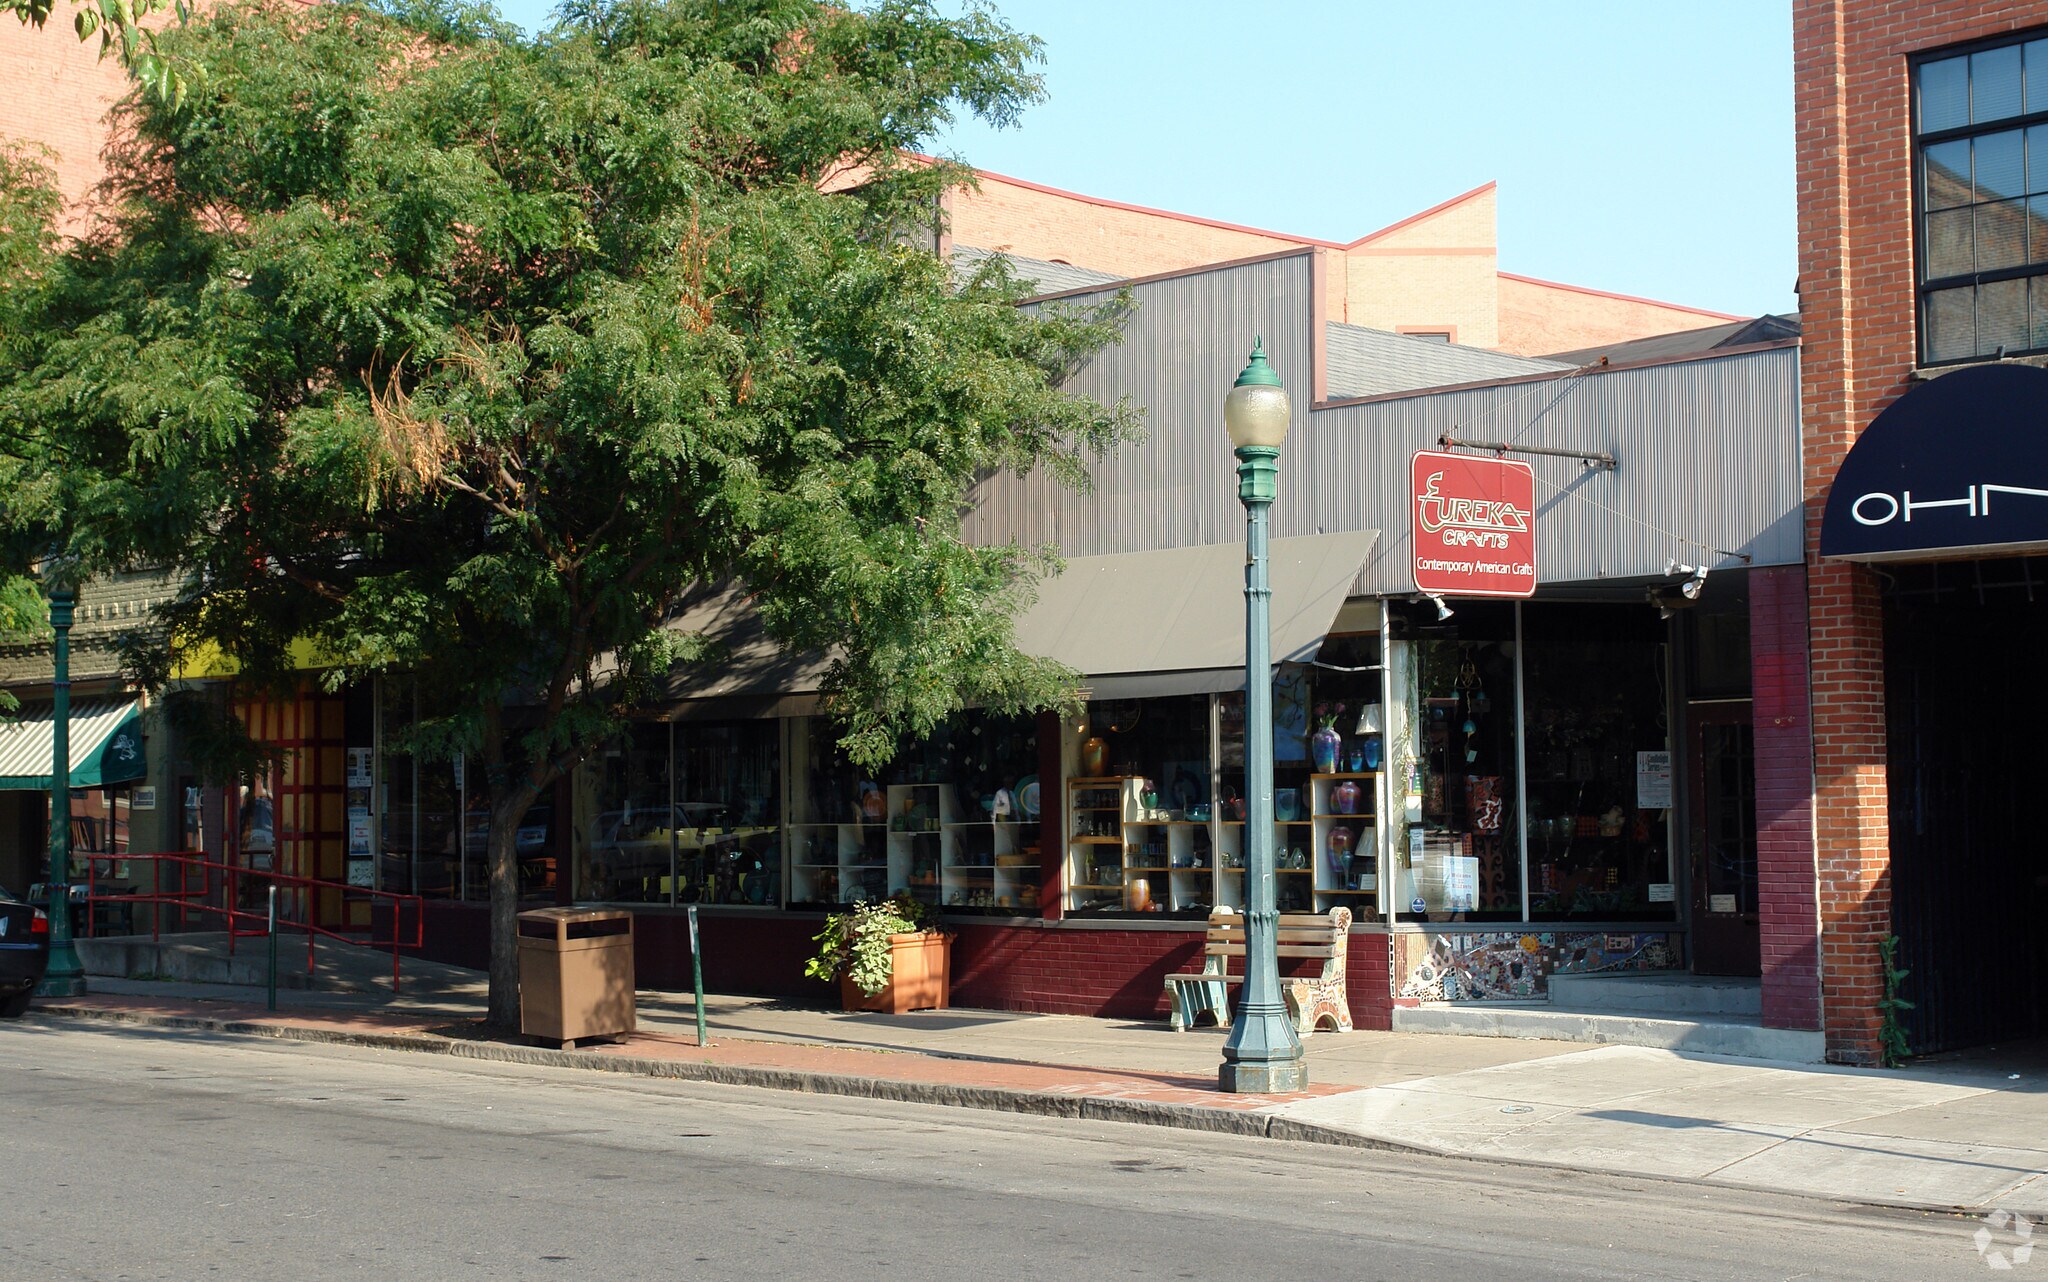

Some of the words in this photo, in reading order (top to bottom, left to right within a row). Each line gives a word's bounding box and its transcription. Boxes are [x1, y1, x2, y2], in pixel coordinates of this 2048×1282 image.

[1418, 471, 1531, 533] EUREKA
[1443, 529, 1509, 549] CRAFTS
[1417, 557, 1473, 576] Contemporary
[1474, 560, 1511, 575] American
[1512, 562, 1533, 576] Crafts
